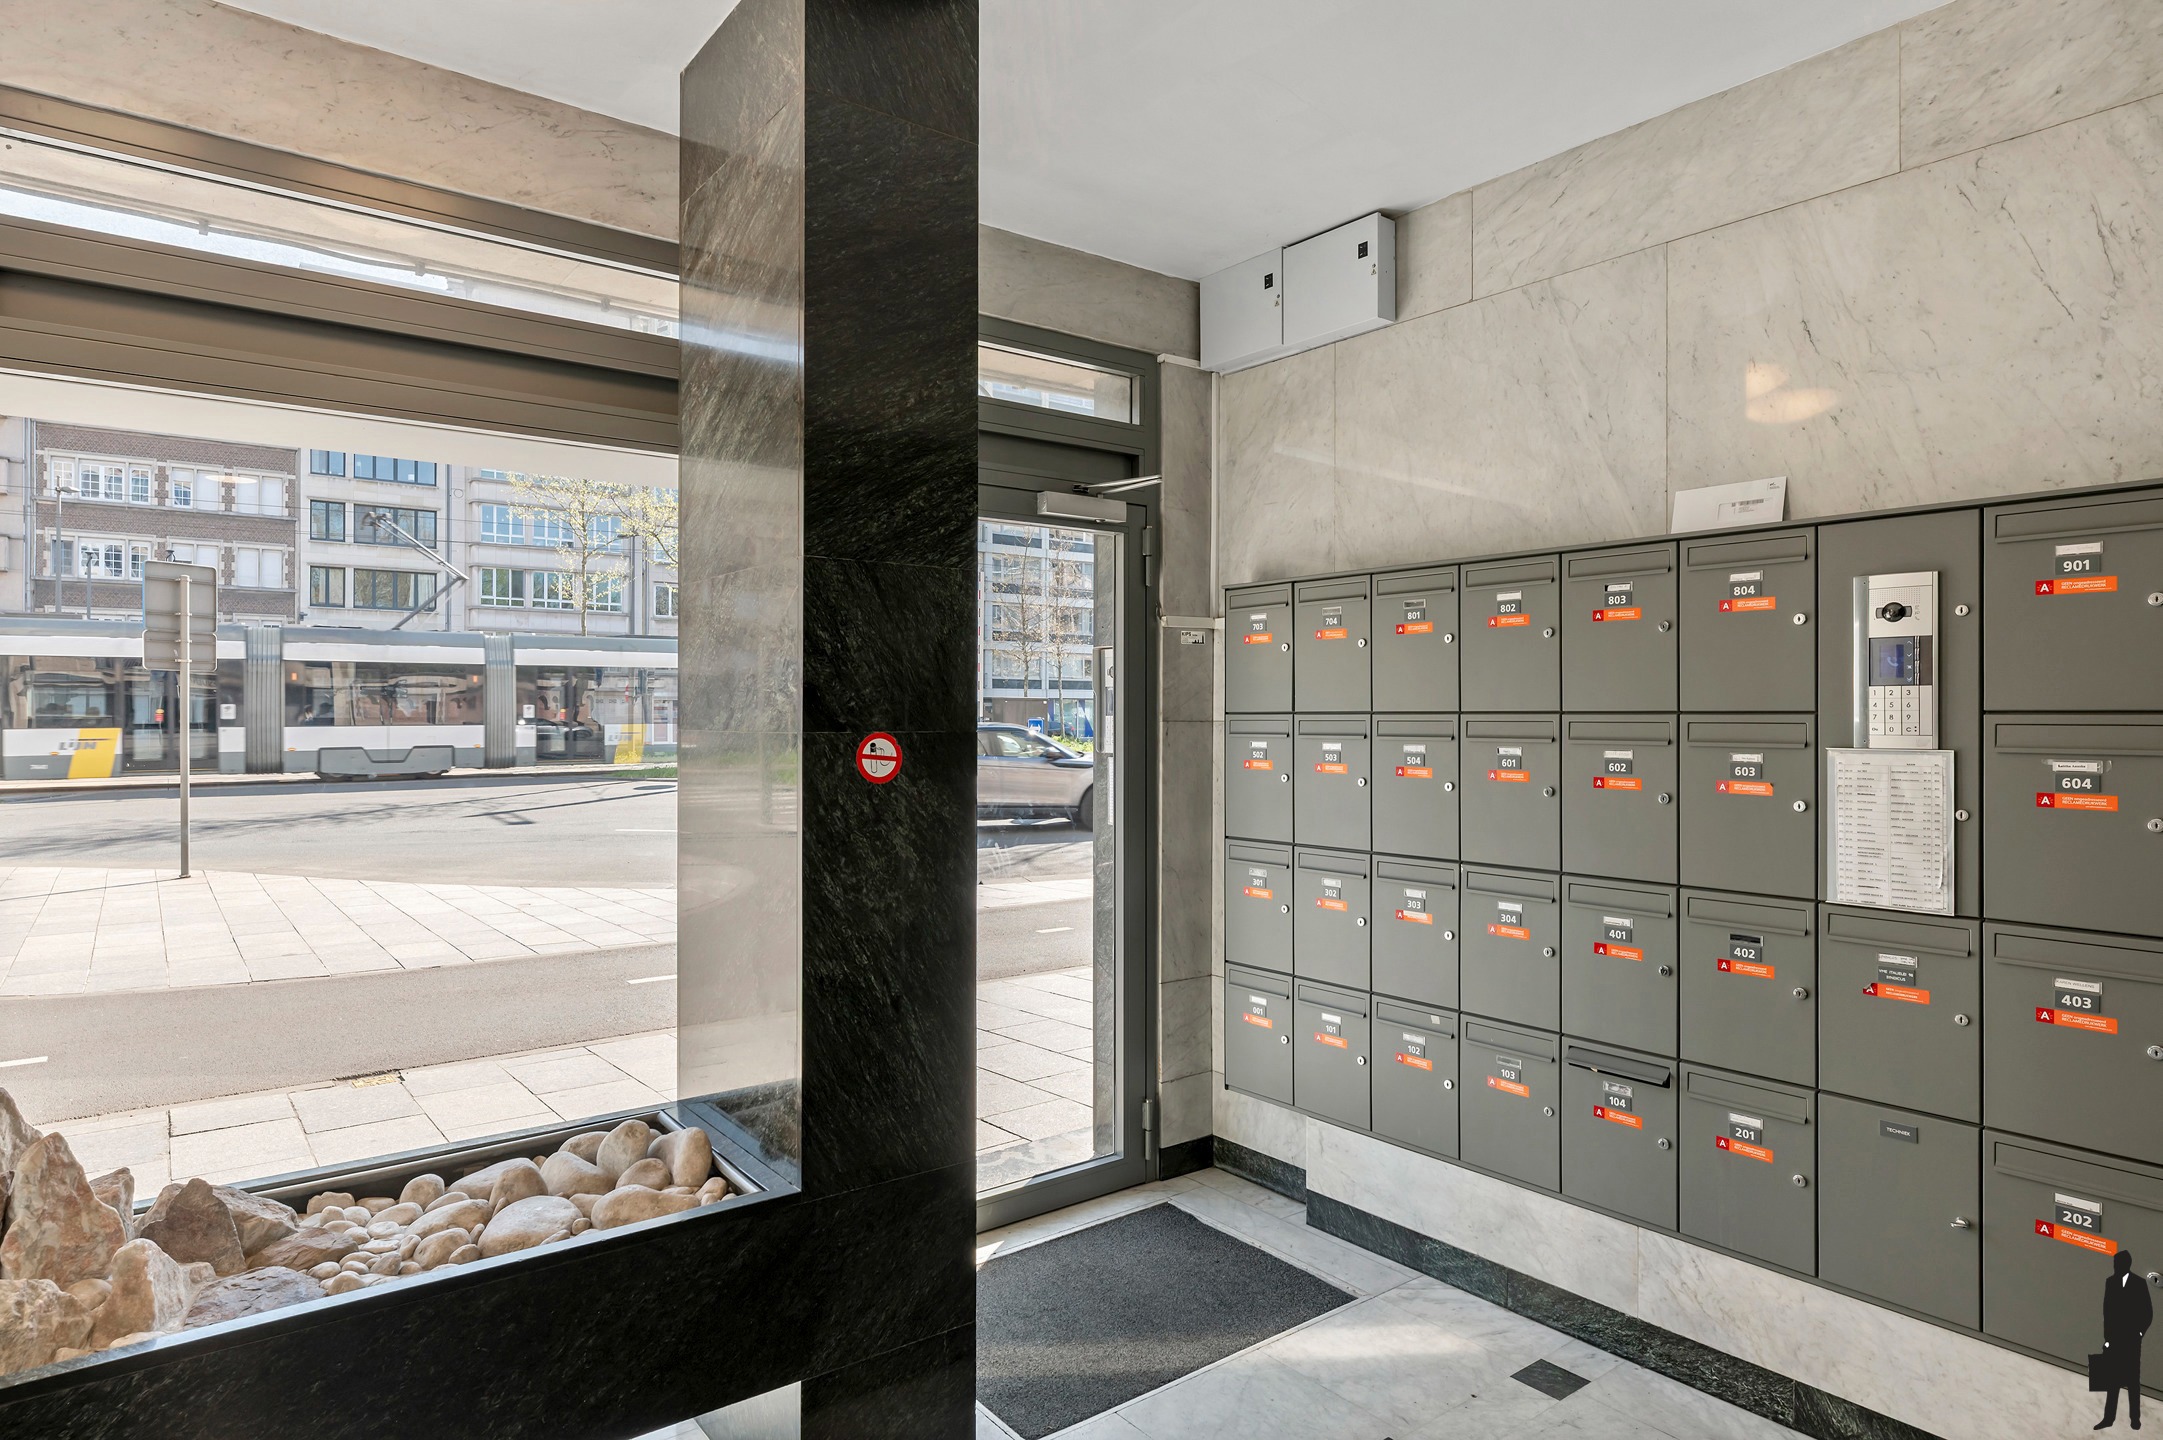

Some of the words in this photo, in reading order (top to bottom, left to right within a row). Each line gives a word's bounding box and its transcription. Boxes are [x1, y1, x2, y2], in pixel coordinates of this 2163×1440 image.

[2063, 560, 2090, 572] 901
[1734, 585, 1755, 596] 804
[2040, 584, 2049, 592] A
[1608, 595, 1626, 604] 803
[1500, 604, 1515, 612] 802
[1408, 612, 1420, 620] 801
[1502, 759, 1516, 767] 601
[1609, 763, 1626, 772] 602
[1735, 767, 1755, 776] 603
[2062, 778, 2092, 789] 604
[2041, 796, 2050, 804] A
[1325, 889, 1336, 897] 302
[1407, 900, 1421, 909] 303
[1501, 914, 1516, 924] 304
[1609, 930, 1626, 940] 401
[1734, 947, 1755, 959] 402
[2062, 995, 2092, 1008] 403
[2041, 1011, 2049, 1020] A
[1326, 1025, 1336, 1033] 101
[1408, 1045, 1420, 1055] 102
[1501, 1069, 1515, 1079] 103
[1609, 1096, 1626, 1107] 104
[1735, 1127, 1755, 1140] 201
[2063, 1211, 2092, 1228] 202
[2040, 1225, 2049, 1234] A
